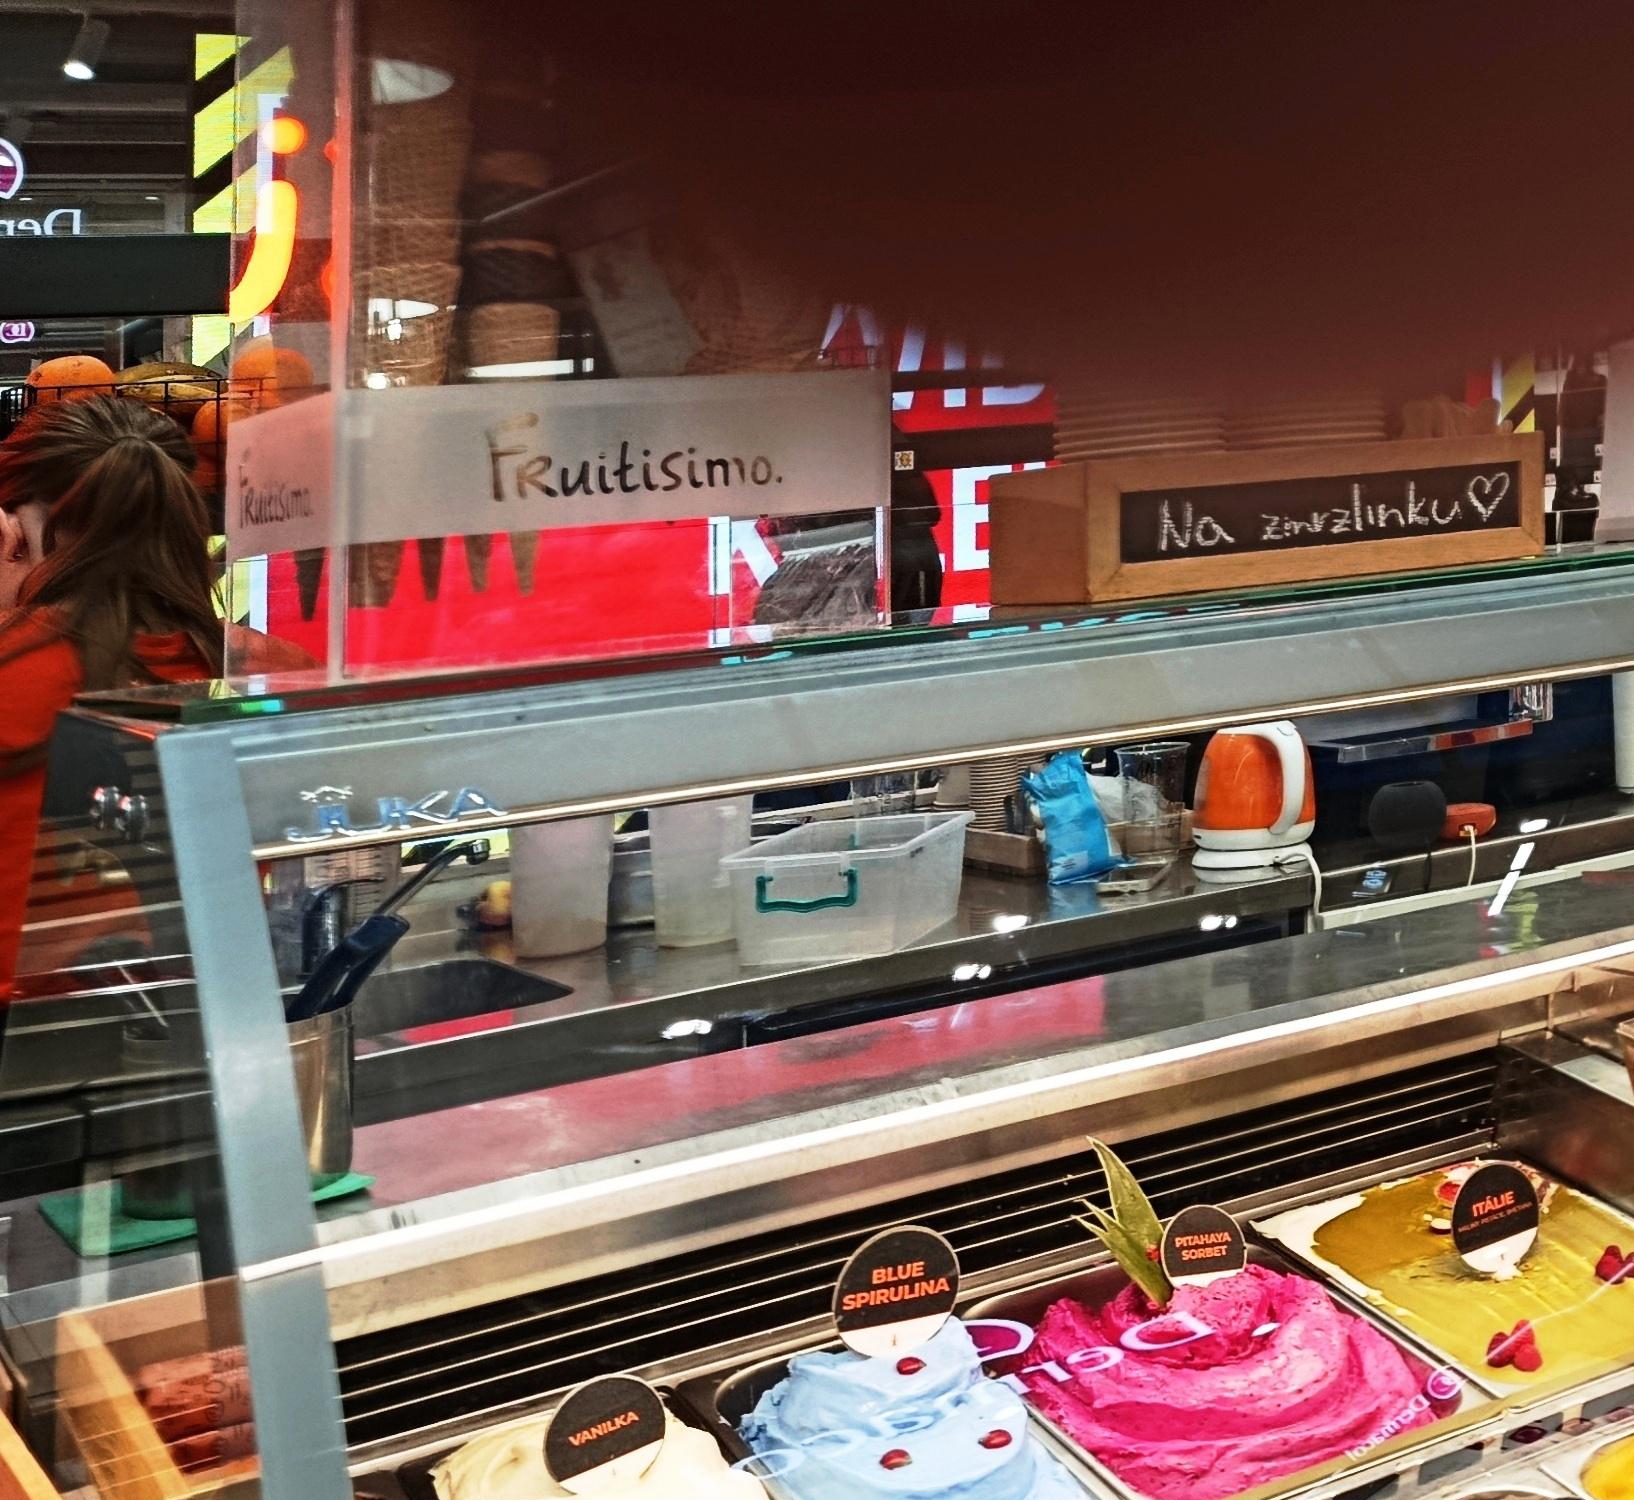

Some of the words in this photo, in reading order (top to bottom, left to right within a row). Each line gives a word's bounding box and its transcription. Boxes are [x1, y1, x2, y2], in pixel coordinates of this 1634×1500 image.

[1158, 498, 1236, 552] Na
[1175, 1231, 1232, 1248] PITAHAYA
[1181, 1245, 1228, 1261] SORBET
[871, 1261, 925, 1285] BLUE
[842, 1277, 950, 1311] SPIRULINA
[567, 1411, 640, 1447] VANILKA
